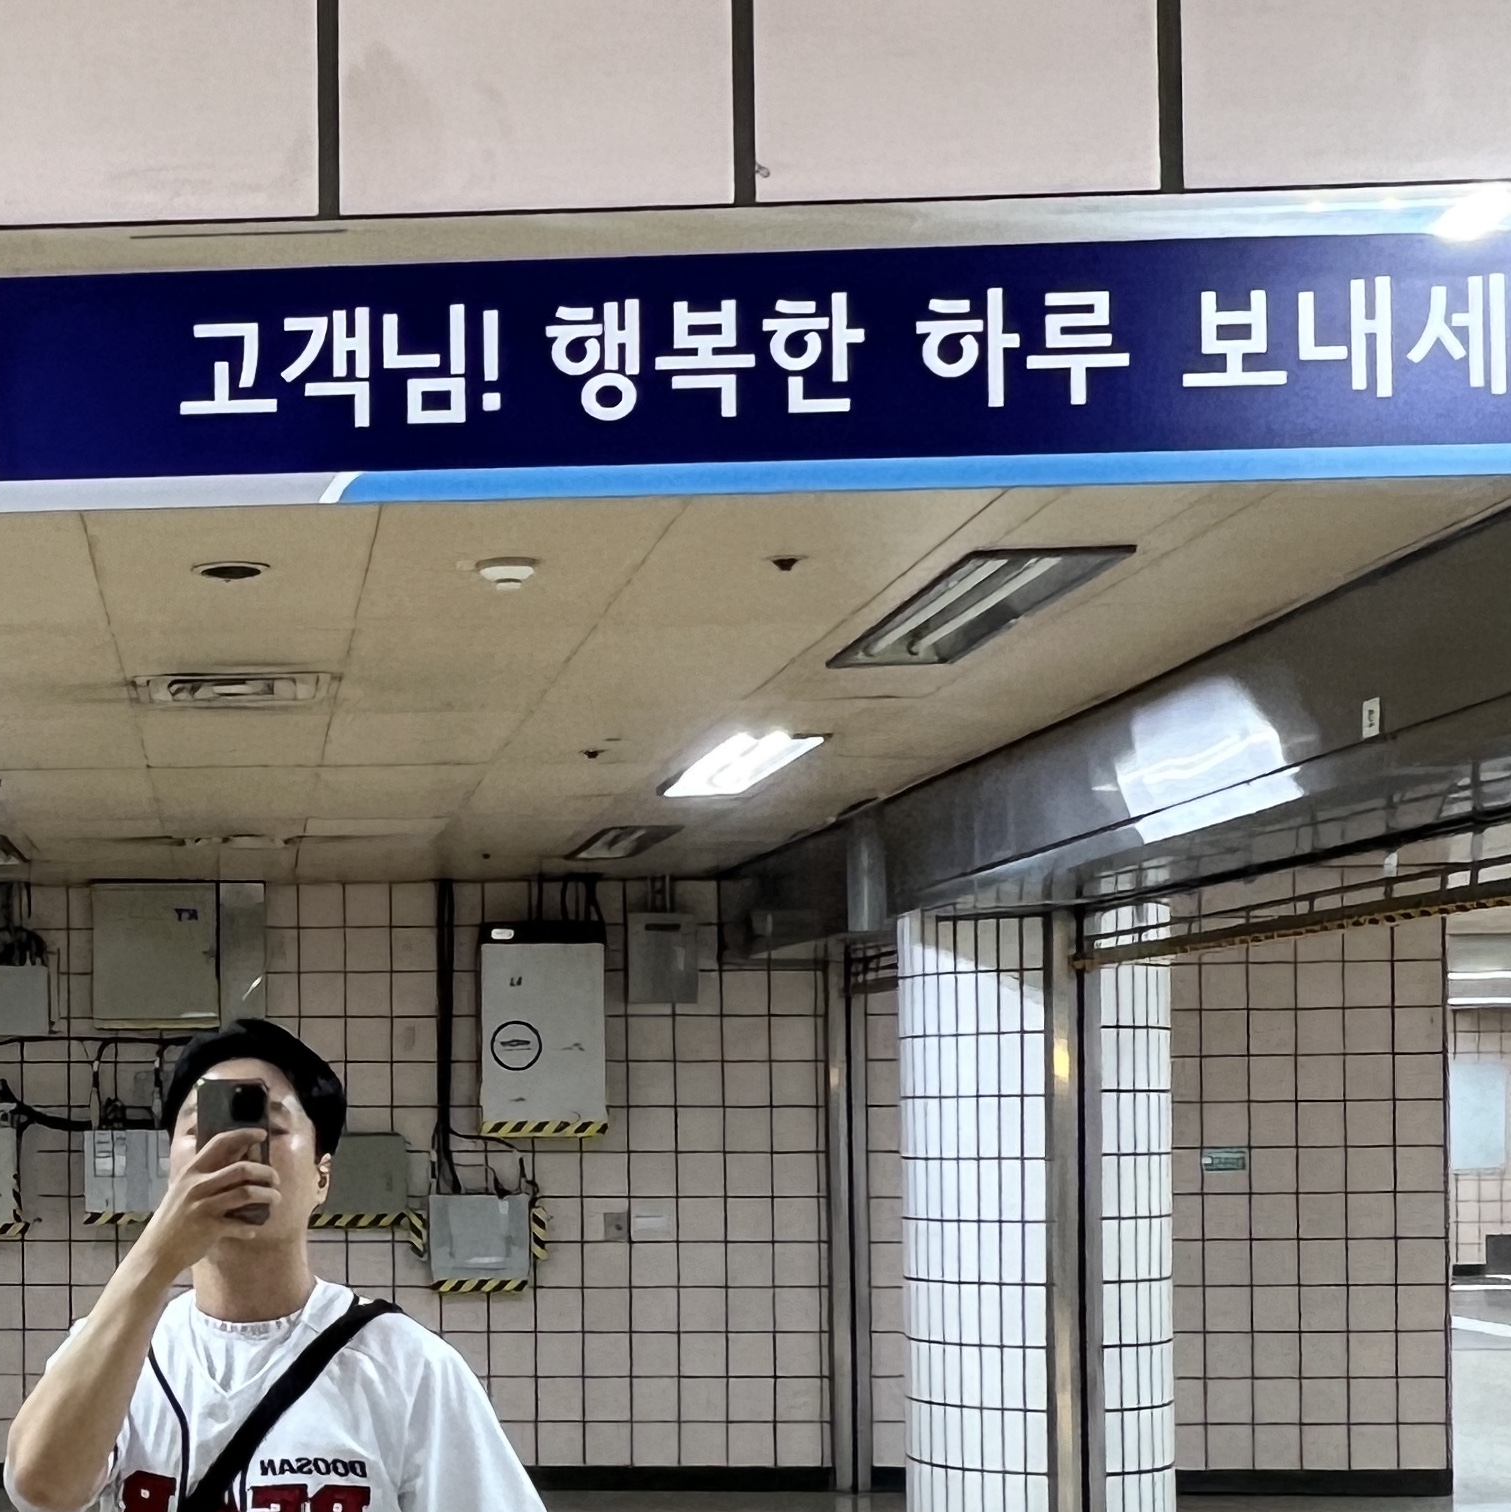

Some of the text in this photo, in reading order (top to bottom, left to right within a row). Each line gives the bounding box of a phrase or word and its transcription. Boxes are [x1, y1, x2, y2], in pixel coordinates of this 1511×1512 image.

[179, 272, 1508, 428] 고객님! 행복한 하루 보내세
